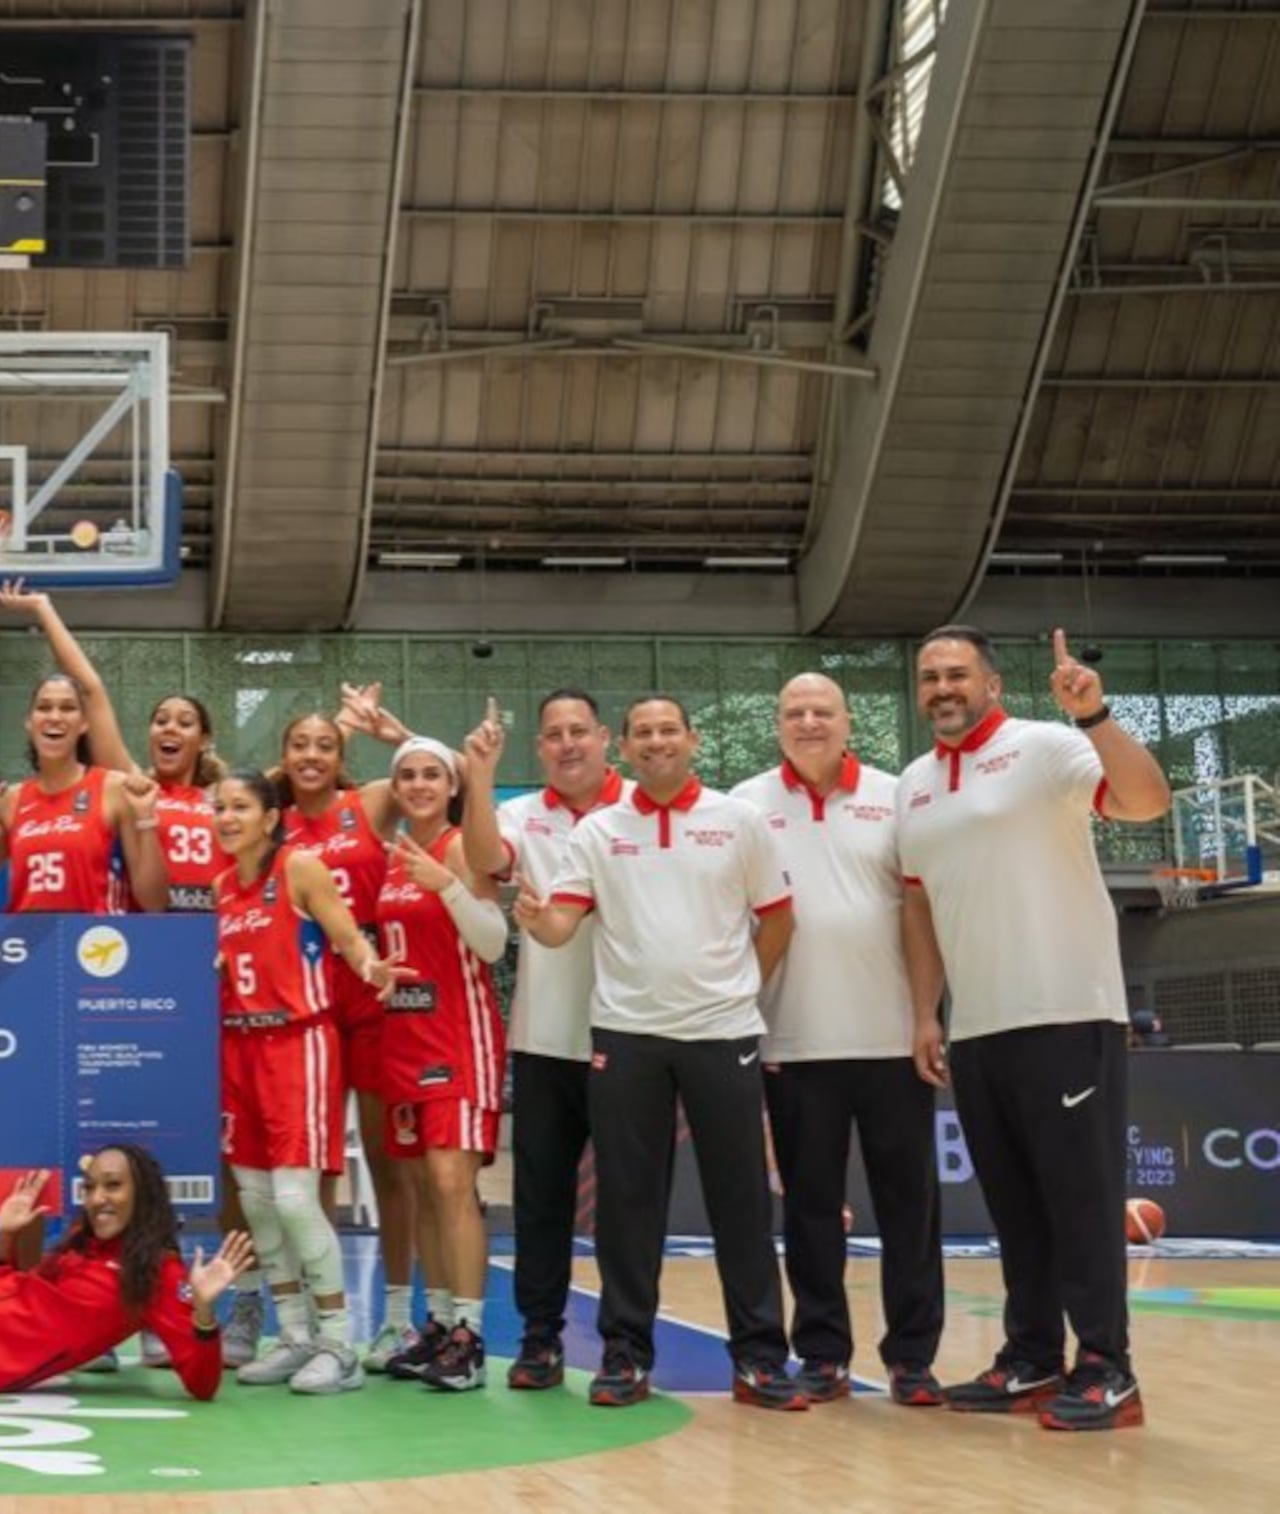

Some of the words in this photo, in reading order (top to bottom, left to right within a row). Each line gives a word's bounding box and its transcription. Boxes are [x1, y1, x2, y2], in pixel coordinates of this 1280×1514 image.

[168, 824, 212, 864] 33
[27, 852, 65, 892] 25
[169, 888, 212, 909] Mobi
[236, 954, 256, 996] 5
[77, 998, 137, 1011] PUERTO
[141, 998, 177, 1010] RICO
[391, 986, 433, 1008] obile
